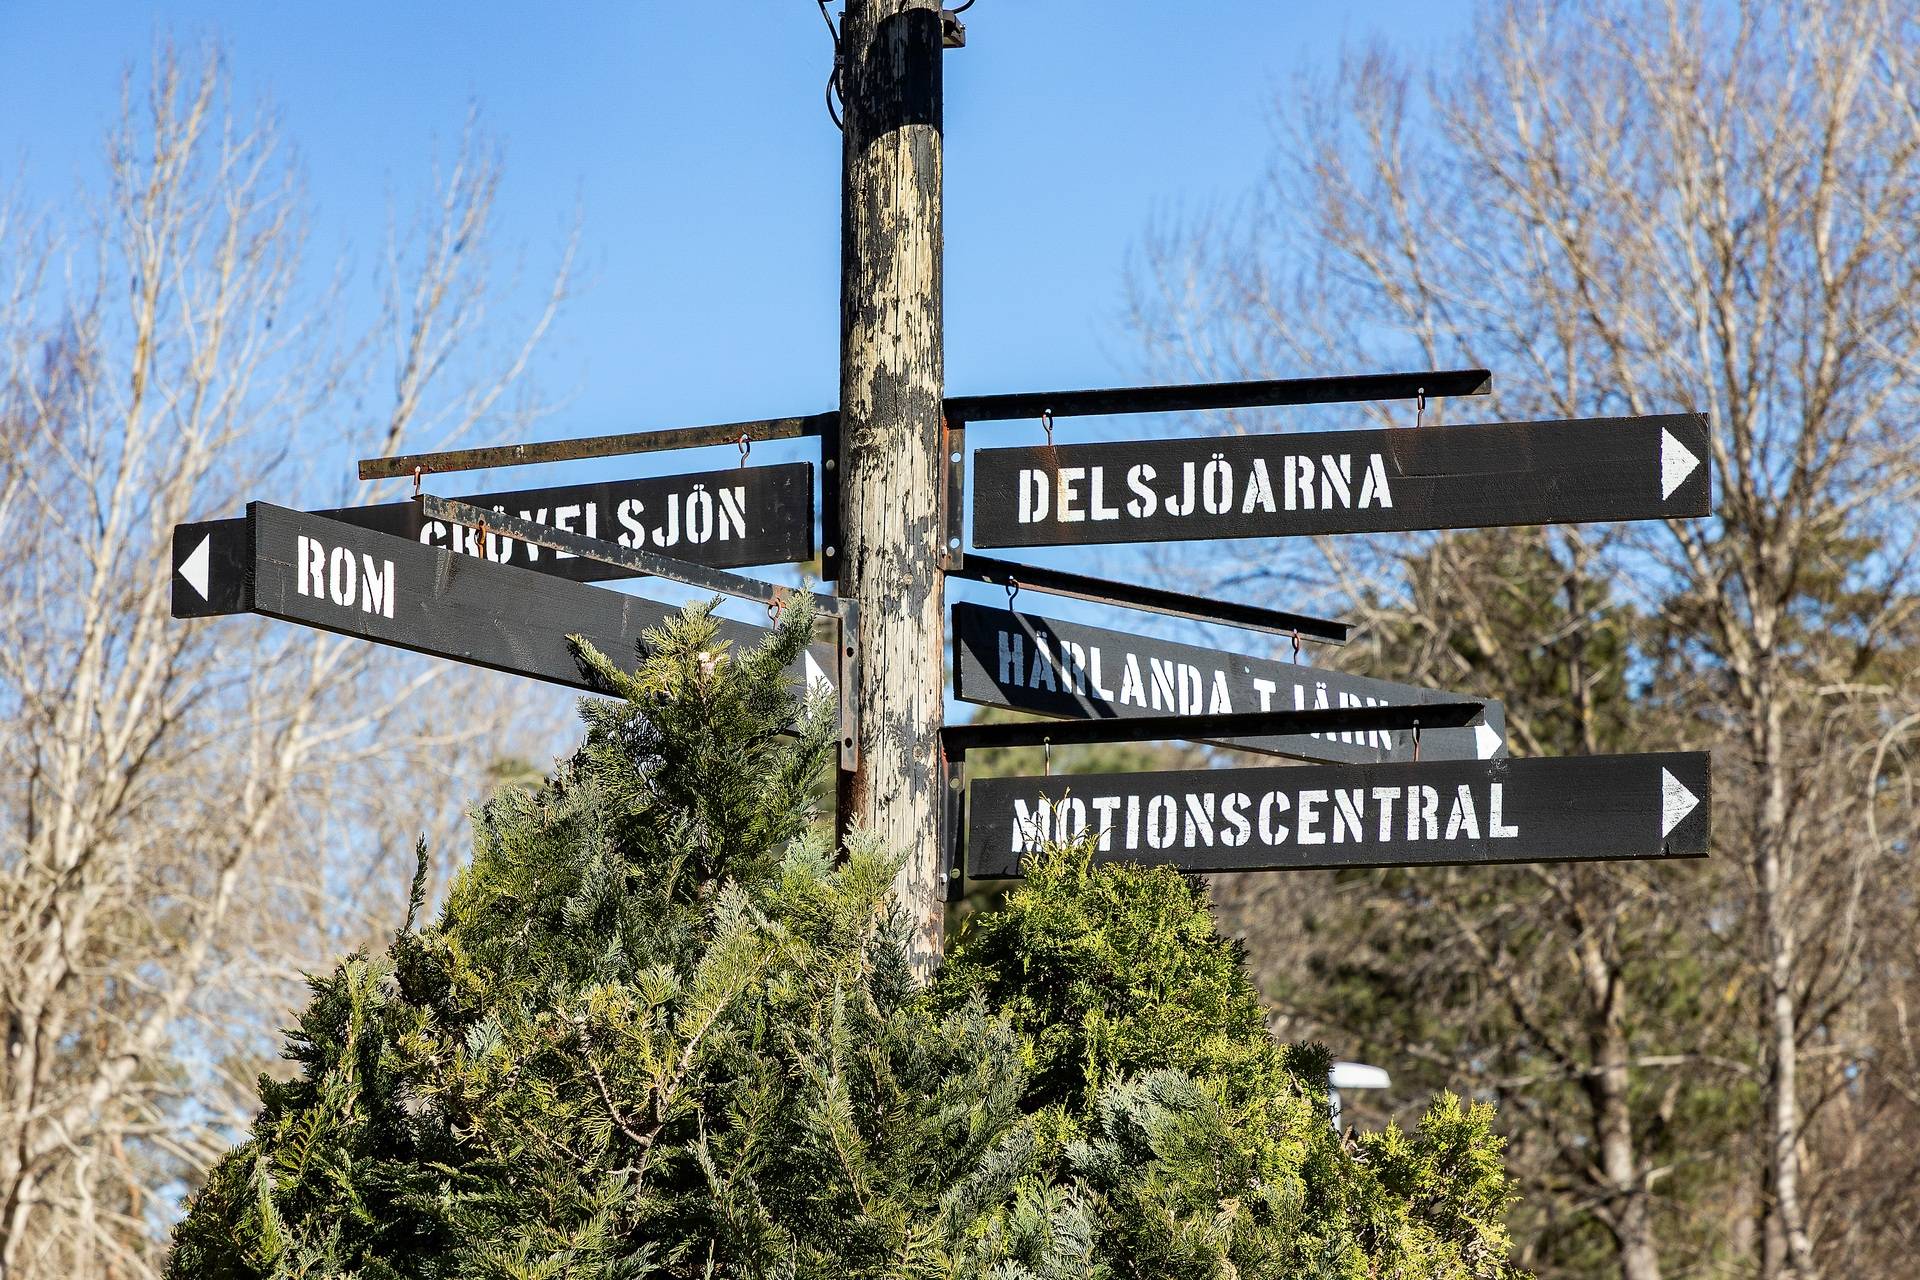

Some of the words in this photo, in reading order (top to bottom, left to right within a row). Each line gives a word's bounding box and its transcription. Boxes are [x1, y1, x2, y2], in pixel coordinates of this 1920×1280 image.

[1018, 453, 1393, 524] DELSJÖARNA
[297, 535, 395, 619] ROM
[998, 630, 1233, 715] HÄRLANDA
[1011, 783, 1519, 853] MOTIONSCENTRAL
